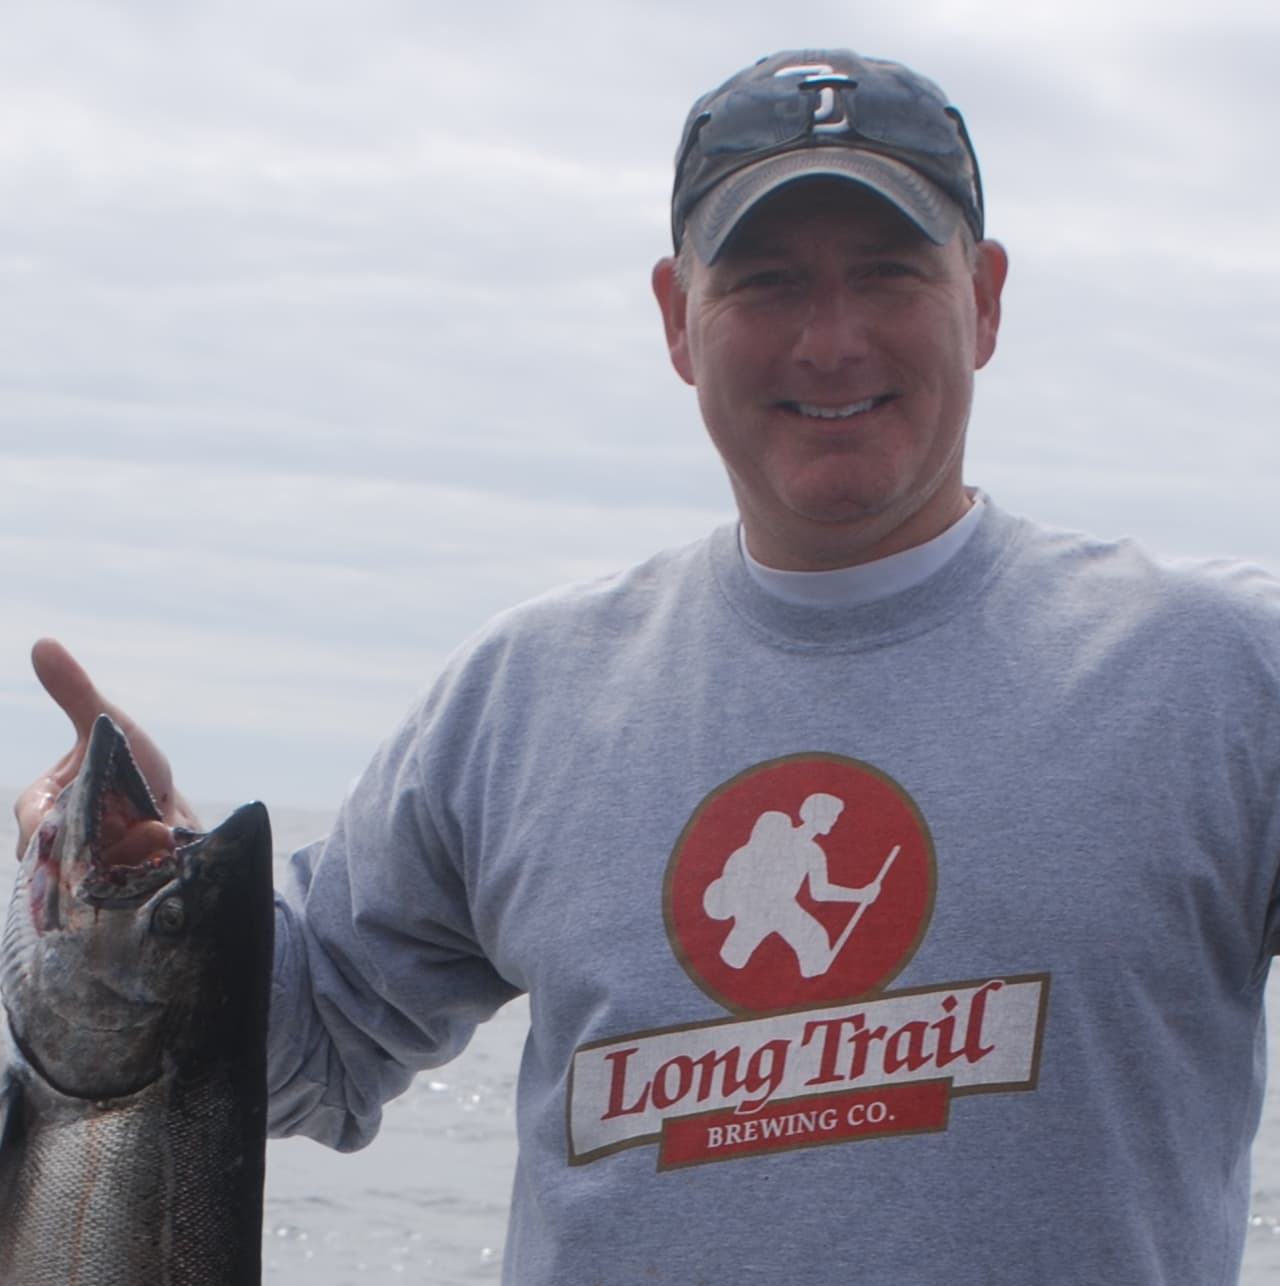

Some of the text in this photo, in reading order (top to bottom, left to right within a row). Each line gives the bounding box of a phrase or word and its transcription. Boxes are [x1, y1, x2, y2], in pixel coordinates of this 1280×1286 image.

[600, 980, 1004, 1121] Long Trail
[706, 1101, 896, 1149] BREWING CO.
